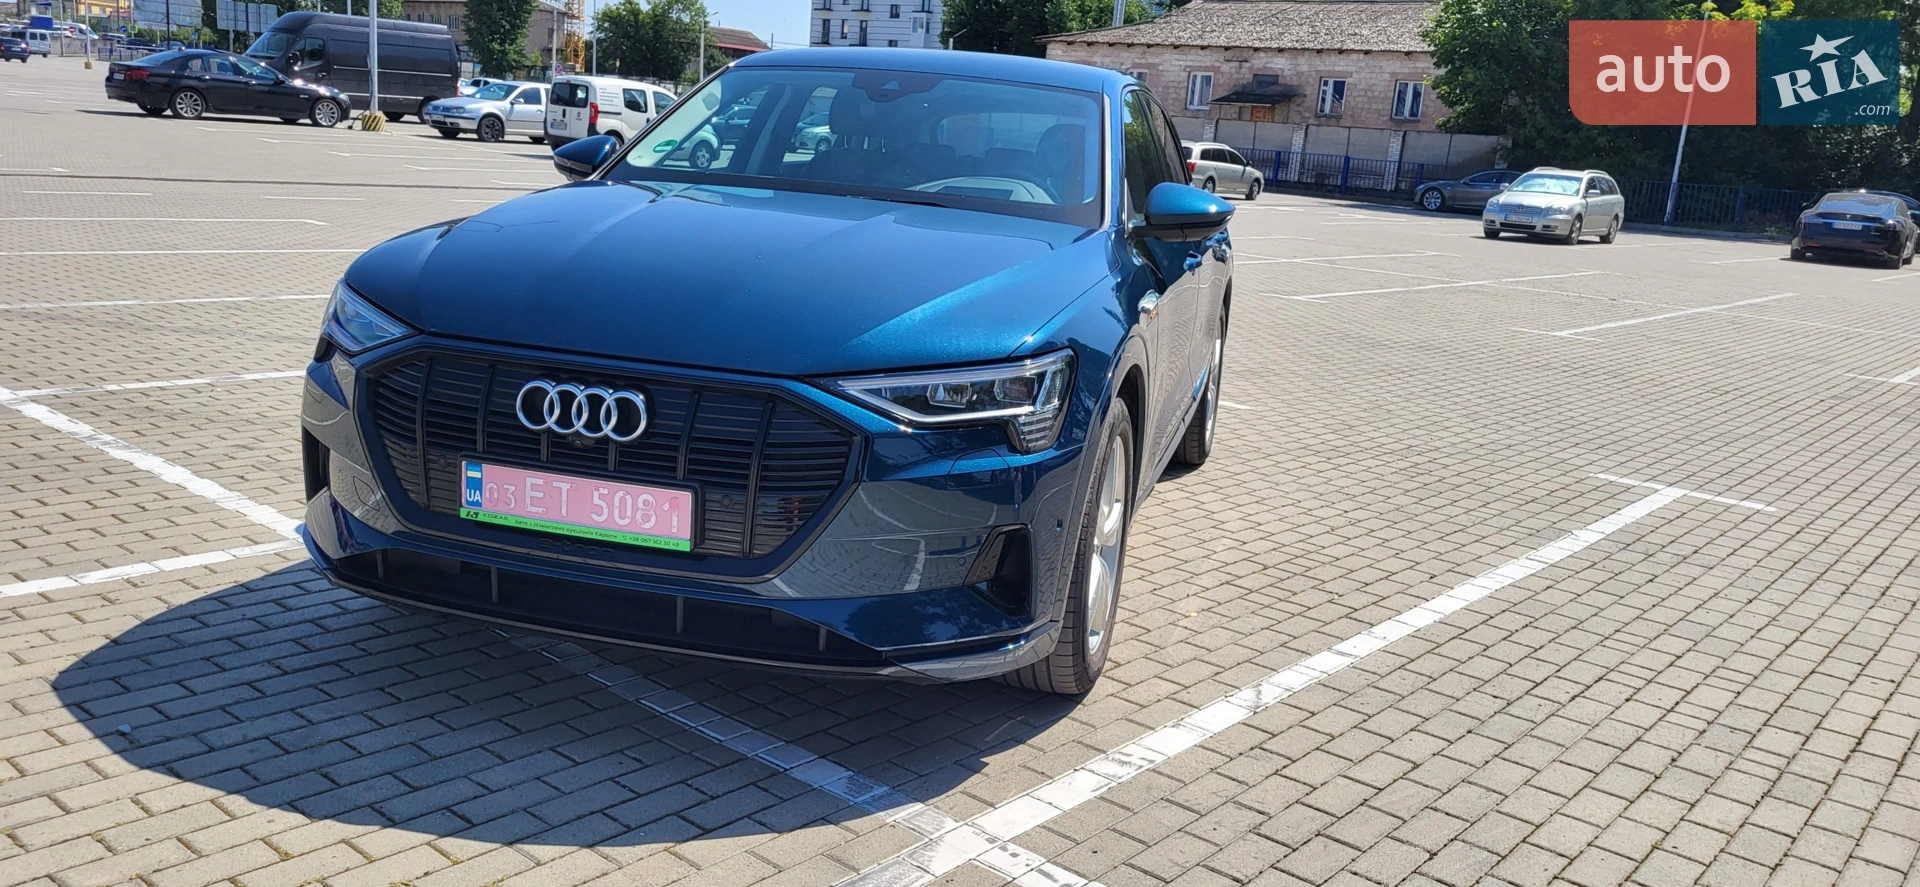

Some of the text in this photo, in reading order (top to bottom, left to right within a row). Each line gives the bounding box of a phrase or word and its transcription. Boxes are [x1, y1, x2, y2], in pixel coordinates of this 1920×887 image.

[466, 489, 482, 502] UA
[486, 476, 680, 533] 03 ET 5081
